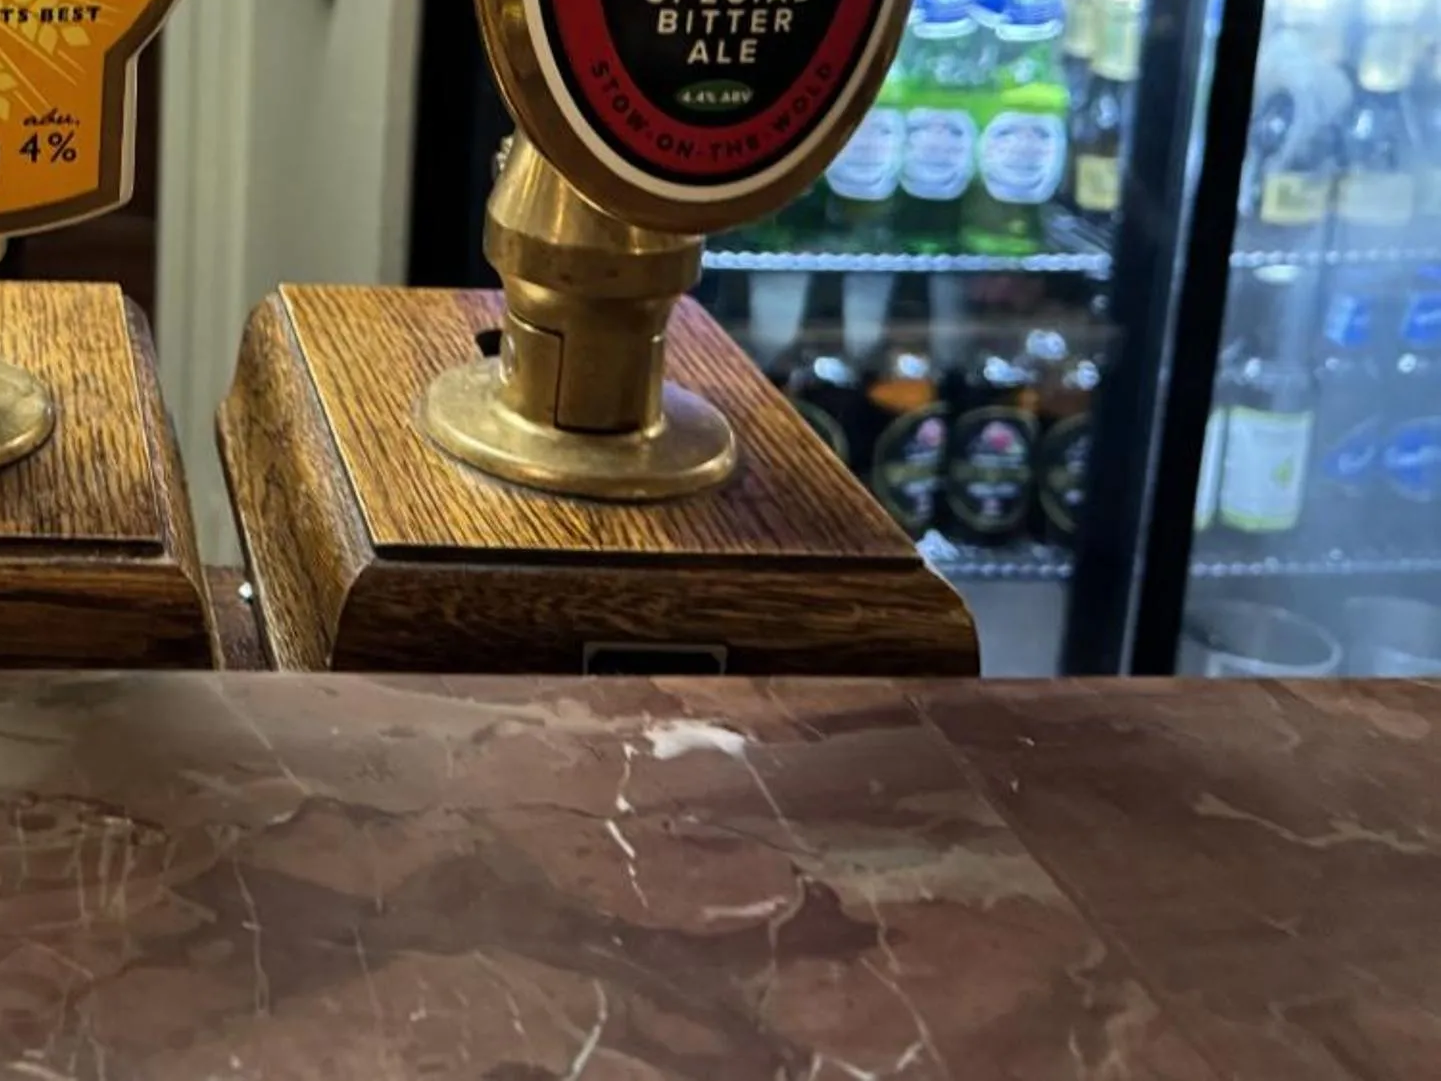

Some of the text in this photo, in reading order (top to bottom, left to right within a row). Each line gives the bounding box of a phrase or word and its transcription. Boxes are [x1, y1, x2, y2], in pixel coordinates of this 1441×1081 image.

[39, 4, 102, 24] BEST
[657, 9, 794, 34] BITTER
[687, 40, 757, 64] ALE
[720, 88, 754, 104] ABV
[18, 130, 77, 164] 4%
